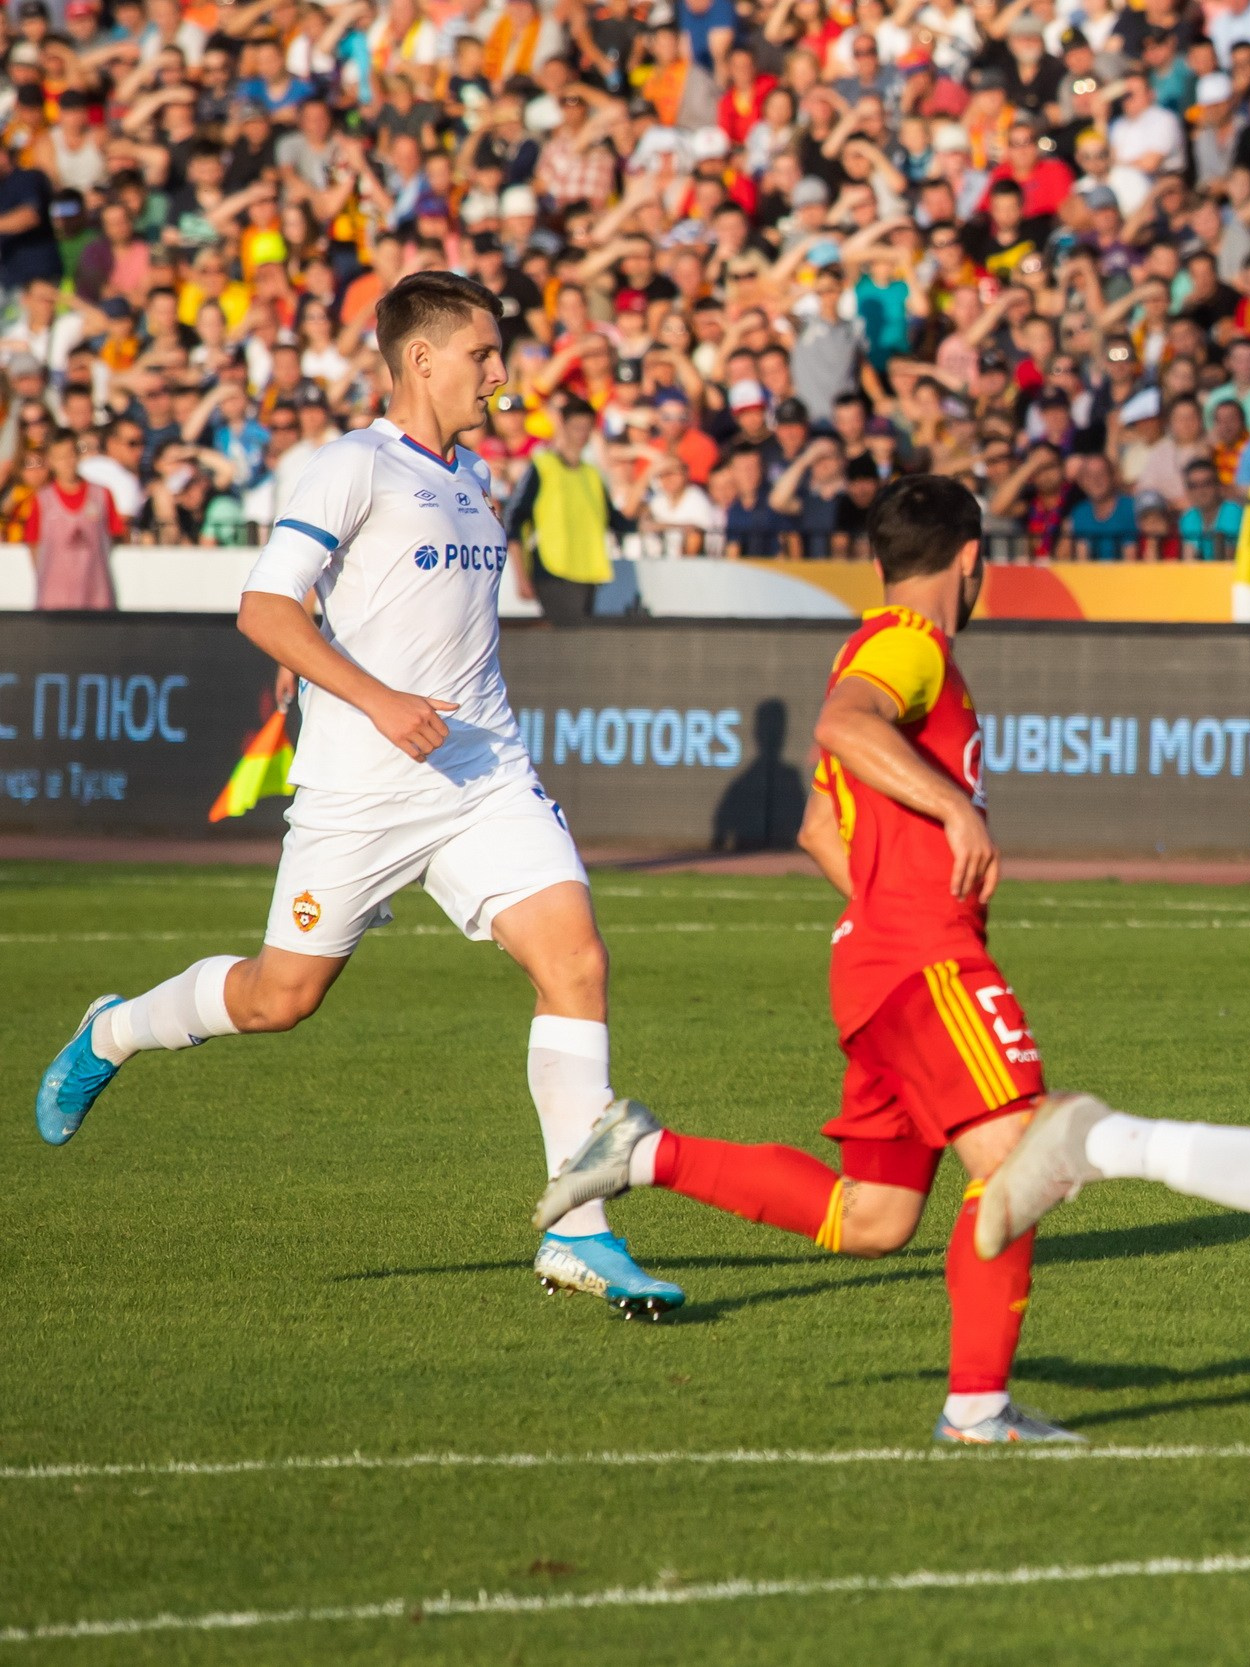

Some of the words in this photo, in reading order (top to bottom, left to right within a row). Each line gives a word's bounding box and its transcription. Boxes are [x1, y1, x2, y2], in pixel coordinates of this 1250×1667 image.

[33, 673, 189, 742] ПЛЮС
[554, 707, 743, 768] MOTORS
[977, 714, 1138, 775] UBISHI
